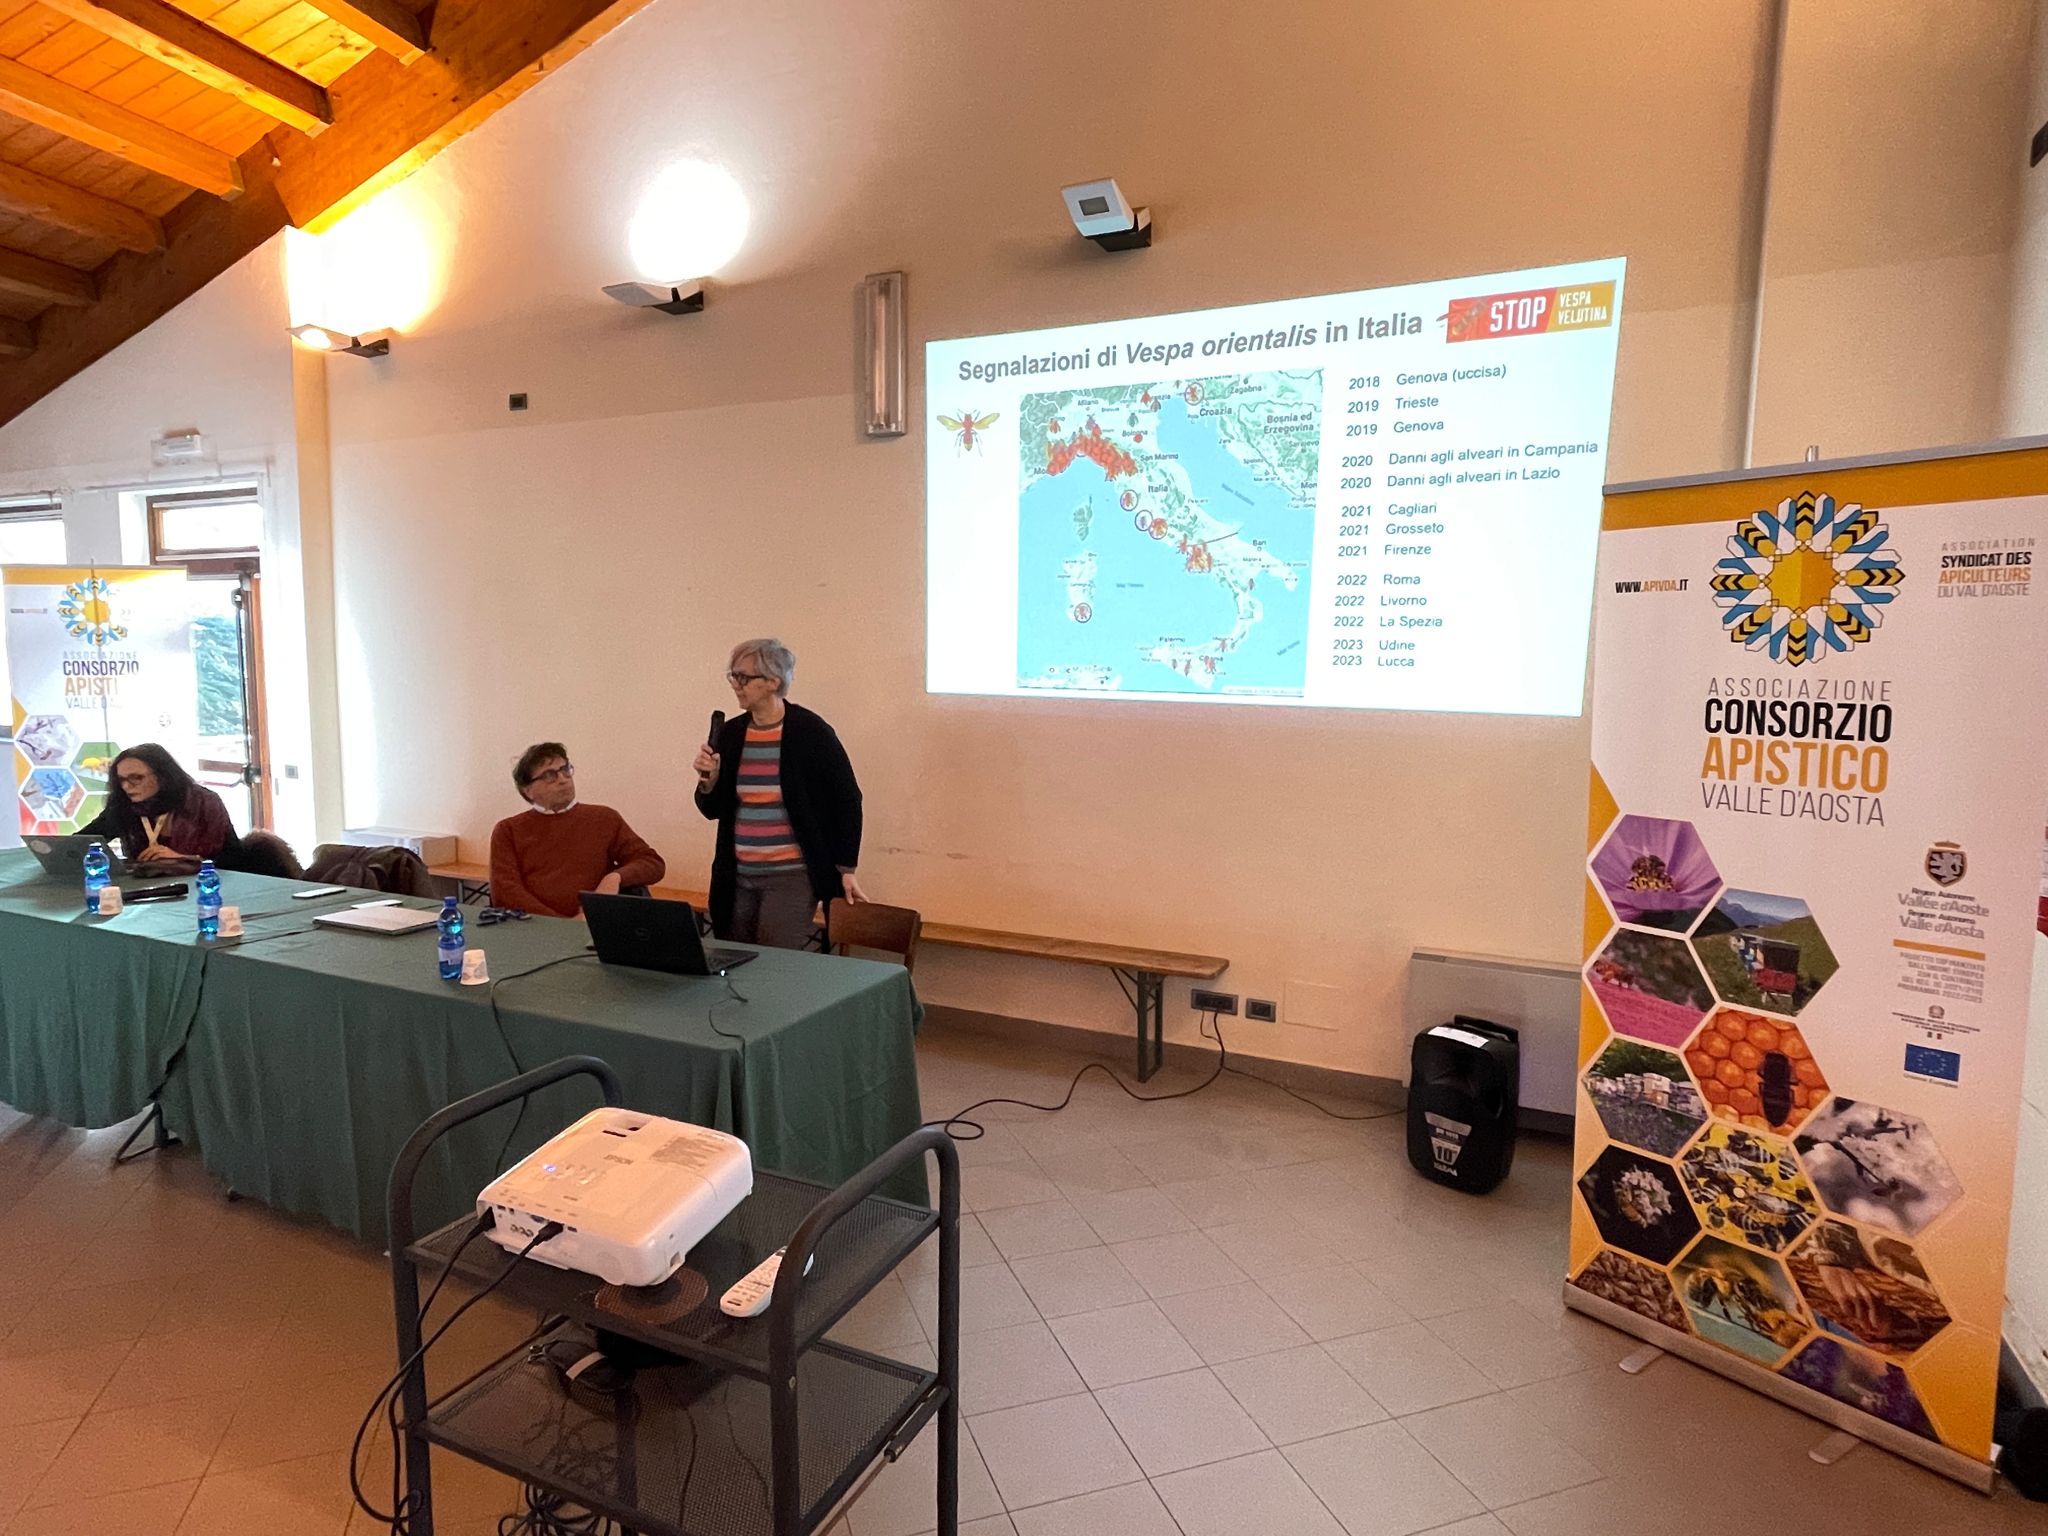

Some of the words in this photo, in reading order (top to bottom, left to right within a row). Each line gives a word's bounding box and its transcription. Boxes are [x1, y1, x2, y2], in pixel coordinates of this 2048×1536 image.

[1559, 291, 1591, 308] VESPA
[1490, 296, 1546, 332] STOP
[1558, 306, 1607, 325] VELUTINA
[958, 348, 1091, 383] Segnalazioni
[1097, 345, 1117, 367] di
[1126, 341, 1194, 369] Vespa
[1202, 324, 1317, 356] orientalis
[1326, 321, 1348, 343] in
[1358, 312, 1422, 340] Italia
[1349, 376, 1380, 390] 2018
[1396, 370, 1448, 386] Genova
[1452, 364, 1507, 382] (uccisa)
[1200, 407, 1232, 417] Croazia
[1347, 400, 1379, 414] 2019
[1395, 395, 1439, 410] Trieste
[1267, 413, 1298, 424] Bosnia
[1301, 411, 1312, 421] ed
[1264, 424, 1314, 435] Erzegovina
[1346, 423, 1378, 437] 2019
[1393, 419, 1444, 433] Genova
[1342, 455, 1373, 468] 2020
[1388, 451, 1427, 465] Danni
[1430, 449, 1453, 465] agli
[1458, 446, 1503, 461] alveari
[1507, 445, 1519, 458] in
[1524, 441, 1598, 460] Campania
[1341, 477, 1372, 490] 2020
[1387, 474, 1425, 488] Danni
[1428, 472, 1452, 488] agli
[1456, 470, 1501, 484] alveari
[1506, 469, 1517, 482] in
[1522, 467, 1561, 481] Lazio
[1148, 484, 1169, 493] Italia
[1341, 505, 1372, 518] 2021
[1388, 503, 1437, 519] Cagliari
[1339, 525, 1369, 537] 2021
[1386, 523, 1444, 536] Grosseto
[1338, 545, 1368, 557] 2021
[1384, 544, 1432, 557] Firenze
[1942, 537, 2036, 552] ASSOCIATION
[1941, 553, 2004, 568] SYNDICAT
[2006, 551, 2032, 566] DES
[1337, 574, 1367, 586] 2022
[1383, 574, 1421, 586] Roma
[1939, 567, 2032, 584] APICULTEURS
[1615, 579, 1689, 594] WWW.APIVDA.IT
[1938, 585, 1953, 598] DU
[1956, 585, 1979, 598] VAL
[1982, 583, 2031, 597] D'AOSTE
[1334, 595, 1365, 607] 2022
[1380, 595, 1427, 607] Livorno
[1333, 616, 1364, 628] 2022
[1380, 616, 1396, 627] La
[1400, 615, 1443, 630] Spezia
[1333, 639, 1364, 651] 2023
[1379, 639, 1415, 651] Udine
[63, 660, 140, 676] CONSORZIO
[1332, 655, 1363, 667] 2023
[1377, 656, 1415, 668] Lucca
[1708, 677, 1893, 701] ASSOCIAZIONE
[1704, 698, 1893, 743] CONSORZIO
[1701, 736, 1889, 793] APISTICO
[1701, 782, 1773, 817] VALLE
[1780, 789, 1885, 827] D'AOSTA
[1898, 893, 1939, 910] Vallée
[1940, 900, 1990, 917] d'Aoste
[1899, 915, 1933, 932] Valle
[1934, 922, 1984, 939] d'Aosta
